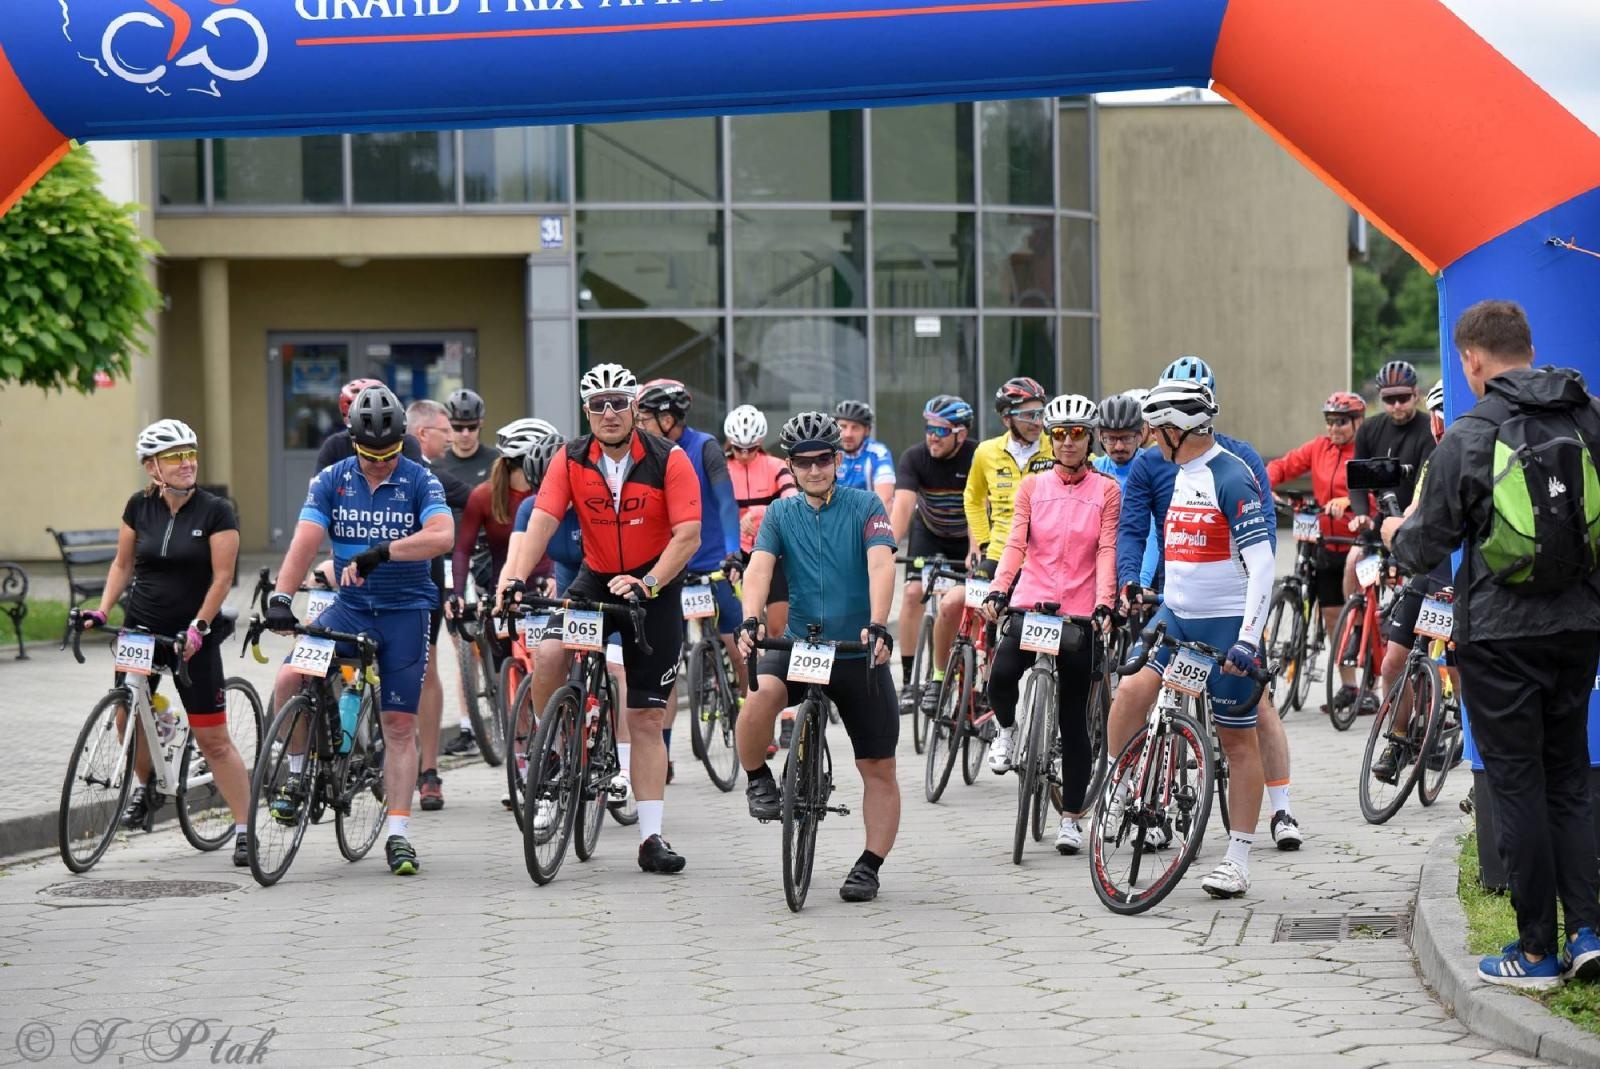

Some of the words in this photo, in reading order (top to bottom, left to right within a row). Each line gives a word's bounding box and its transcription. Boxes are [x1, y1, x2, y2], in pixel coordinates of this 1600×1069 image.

[541, 218, 562, 241] 31
[332, 505, 415, 527] changing
[333, 522, 409, 540] diabetes
[684, 594, 711, 607] 4158
[1421, 609, 1452, 627] 3333
[567, 621, 598, 636] 065
[1025, 624, 1060, 640] 2079
[119, 645, 151, 660] 2091
[295, 646, 330, 663] 2224
[792, 655, 831, 670] 2094
[1174, 661, 1208, 682] 3059
